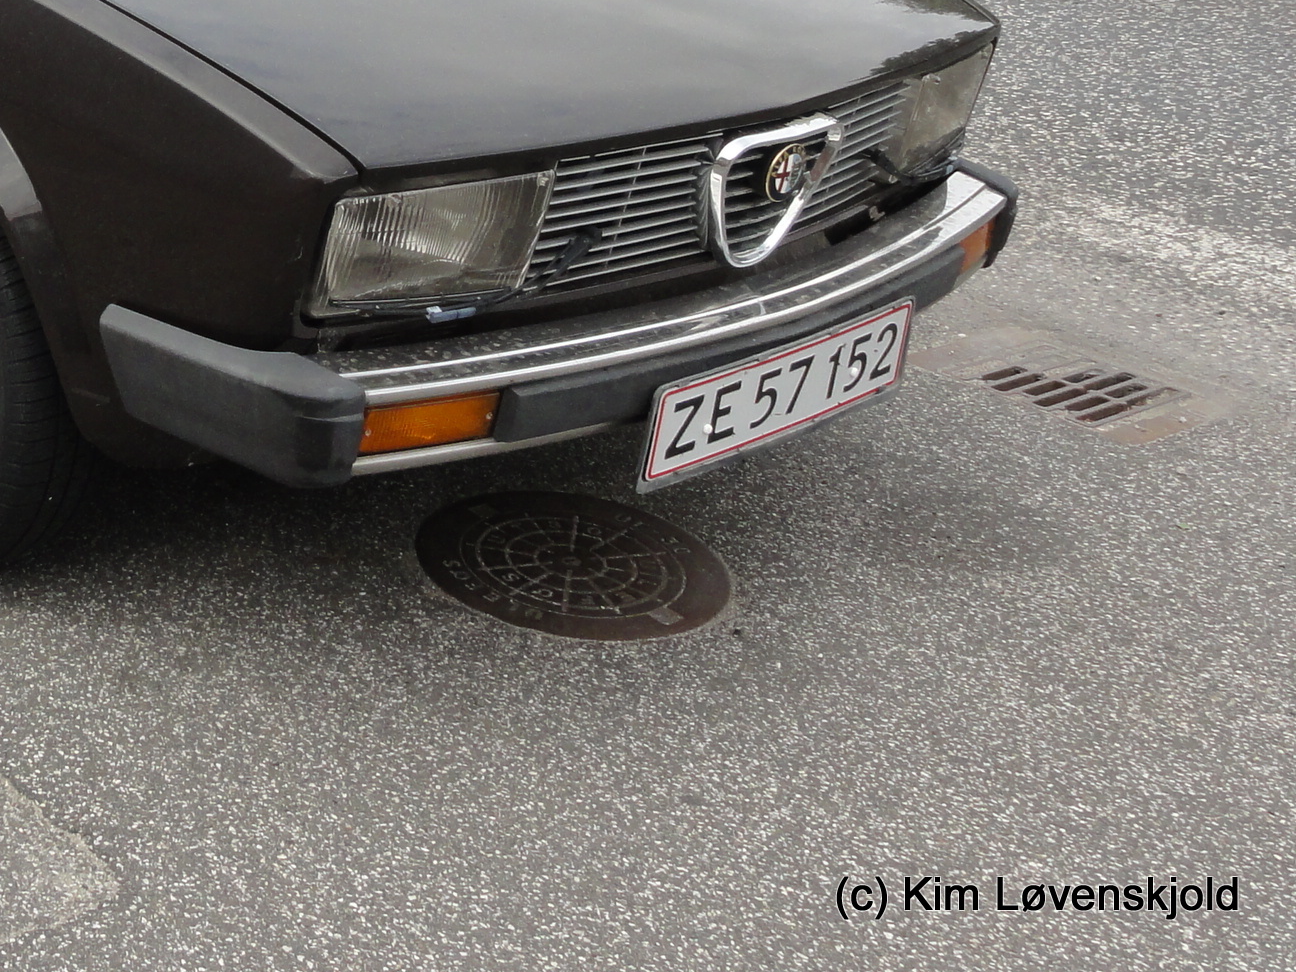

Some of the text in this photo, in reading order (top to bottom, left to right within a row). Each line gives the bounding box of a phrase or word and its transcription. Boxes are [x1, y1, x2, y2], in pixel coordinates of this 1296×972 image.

[665, 323, 898, 460] ZE 57 152
